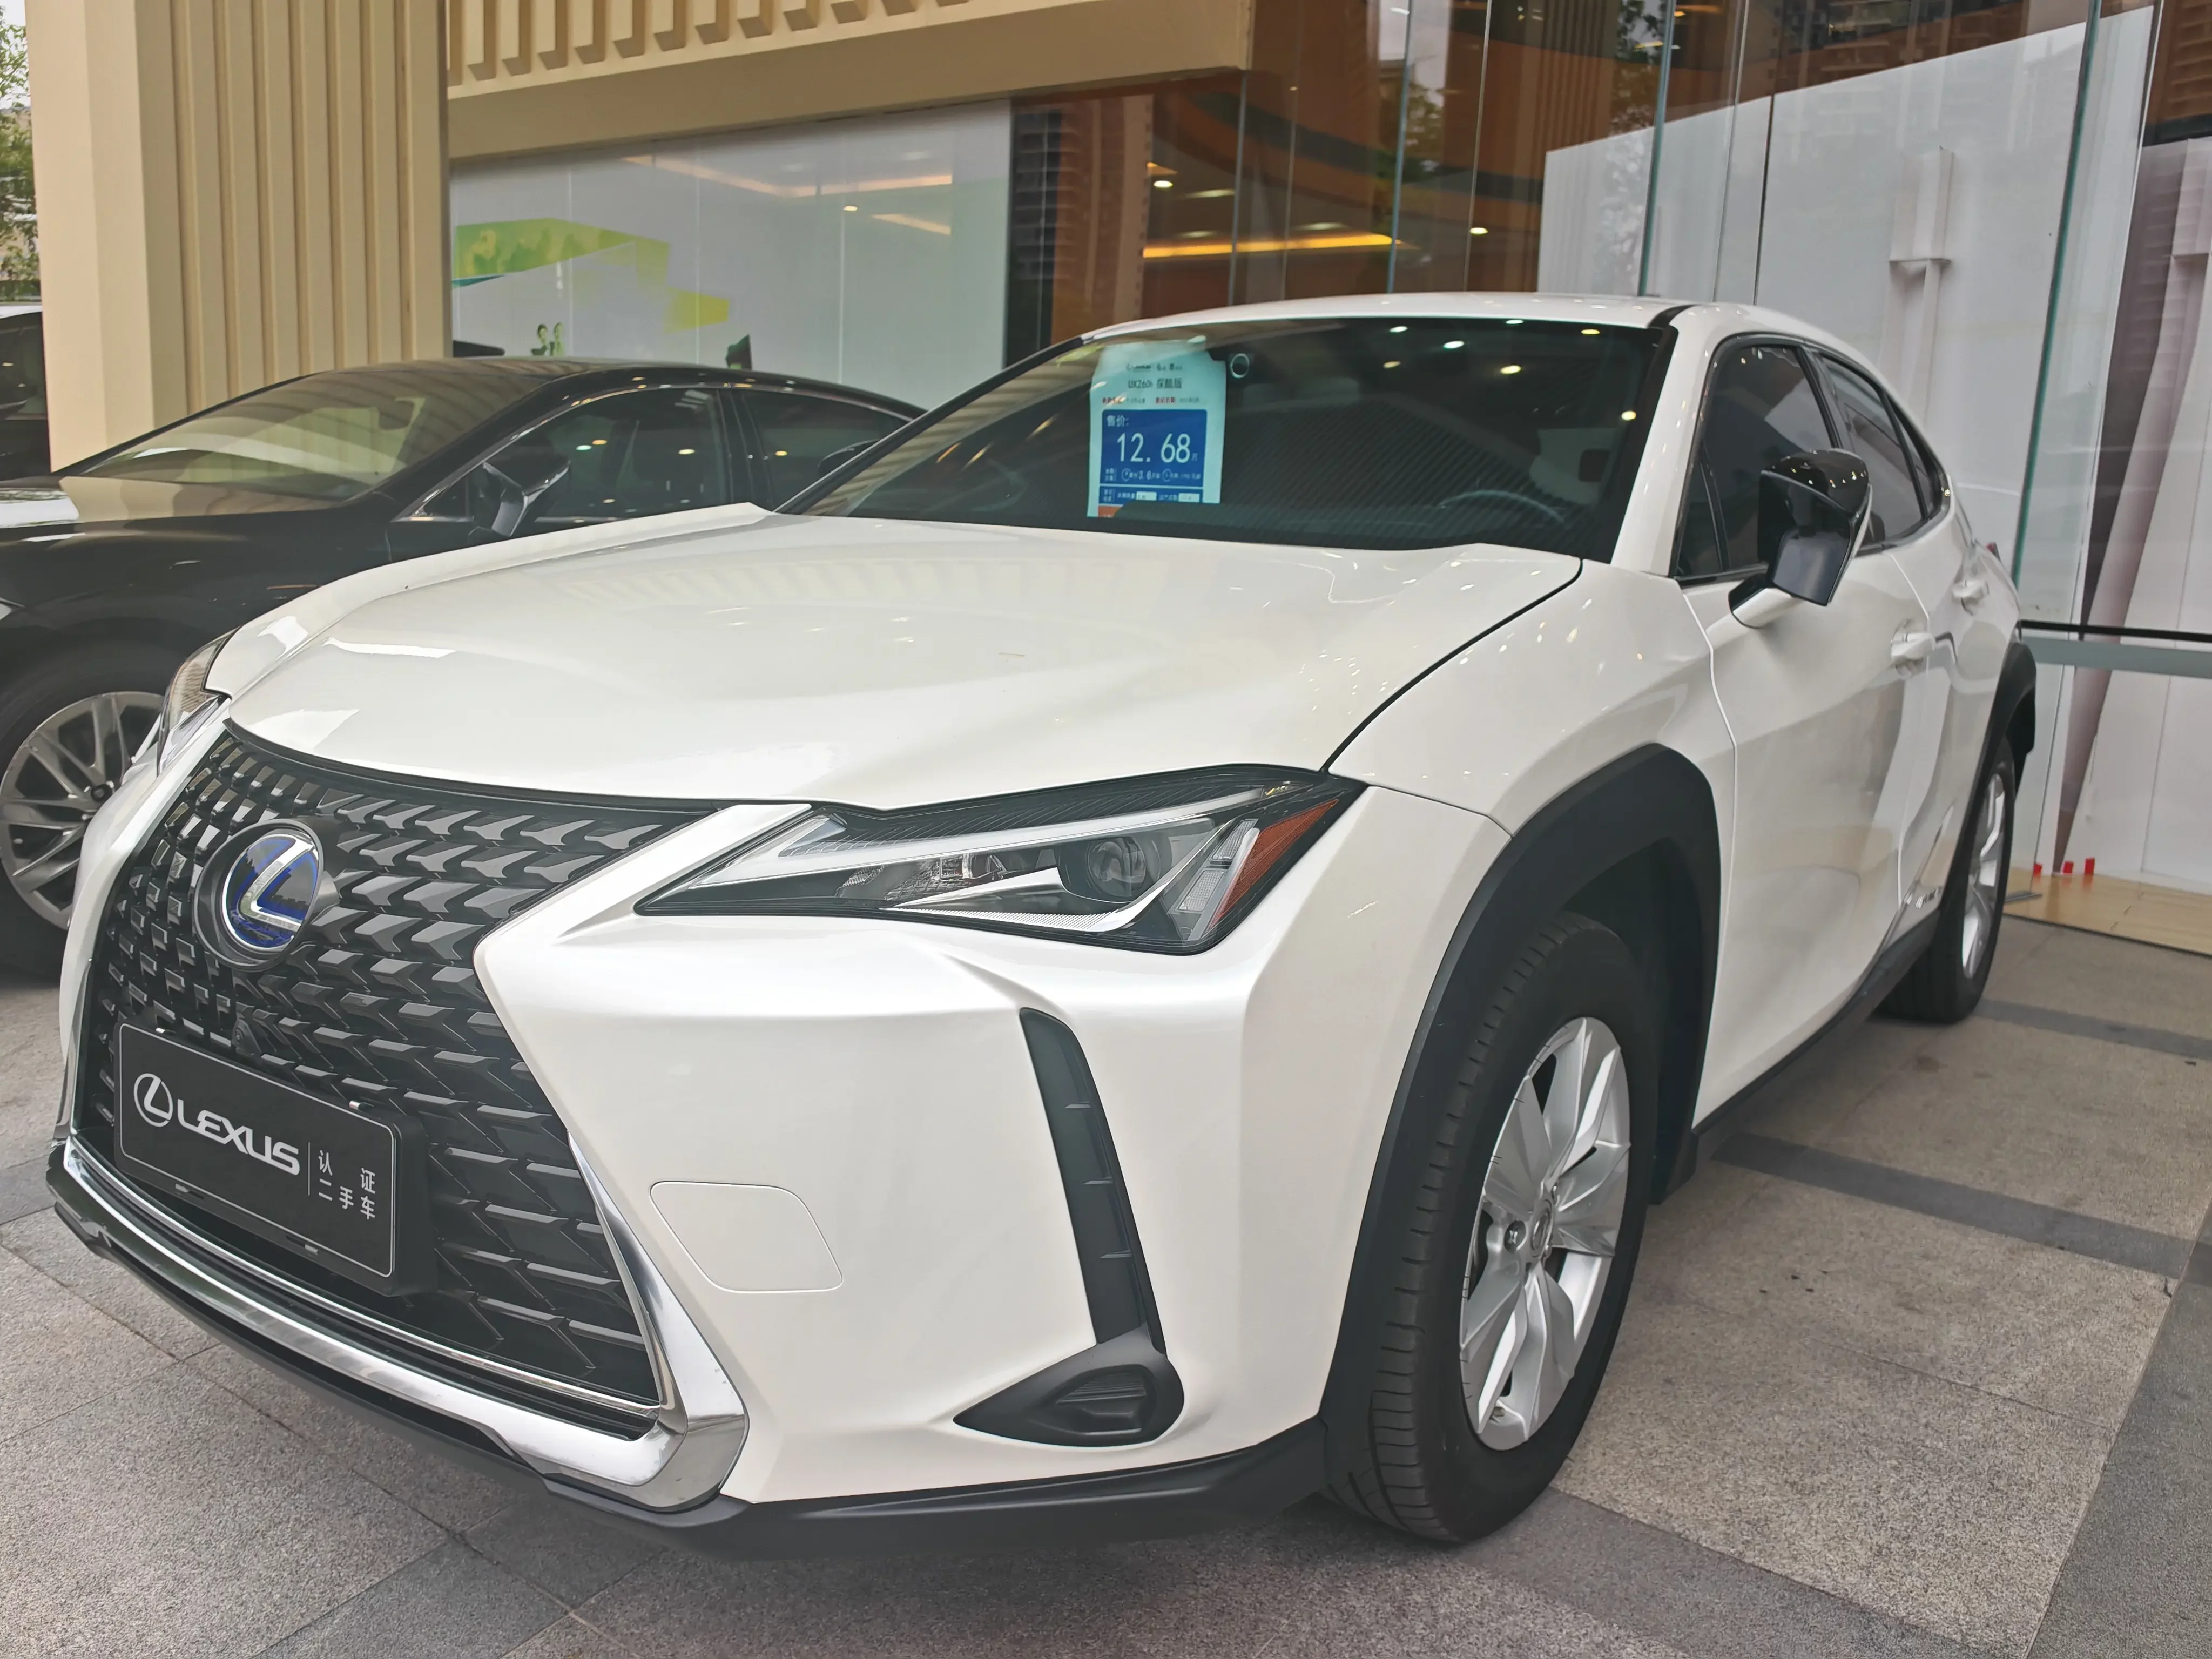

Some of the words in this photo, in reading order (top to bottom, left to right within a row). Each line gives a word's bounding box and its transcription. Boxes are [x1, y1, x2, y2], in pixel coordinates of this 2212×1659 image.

[177, 1098, 300, 1176] LEXUS
[318, 1178, 376, 1220] 二手车
